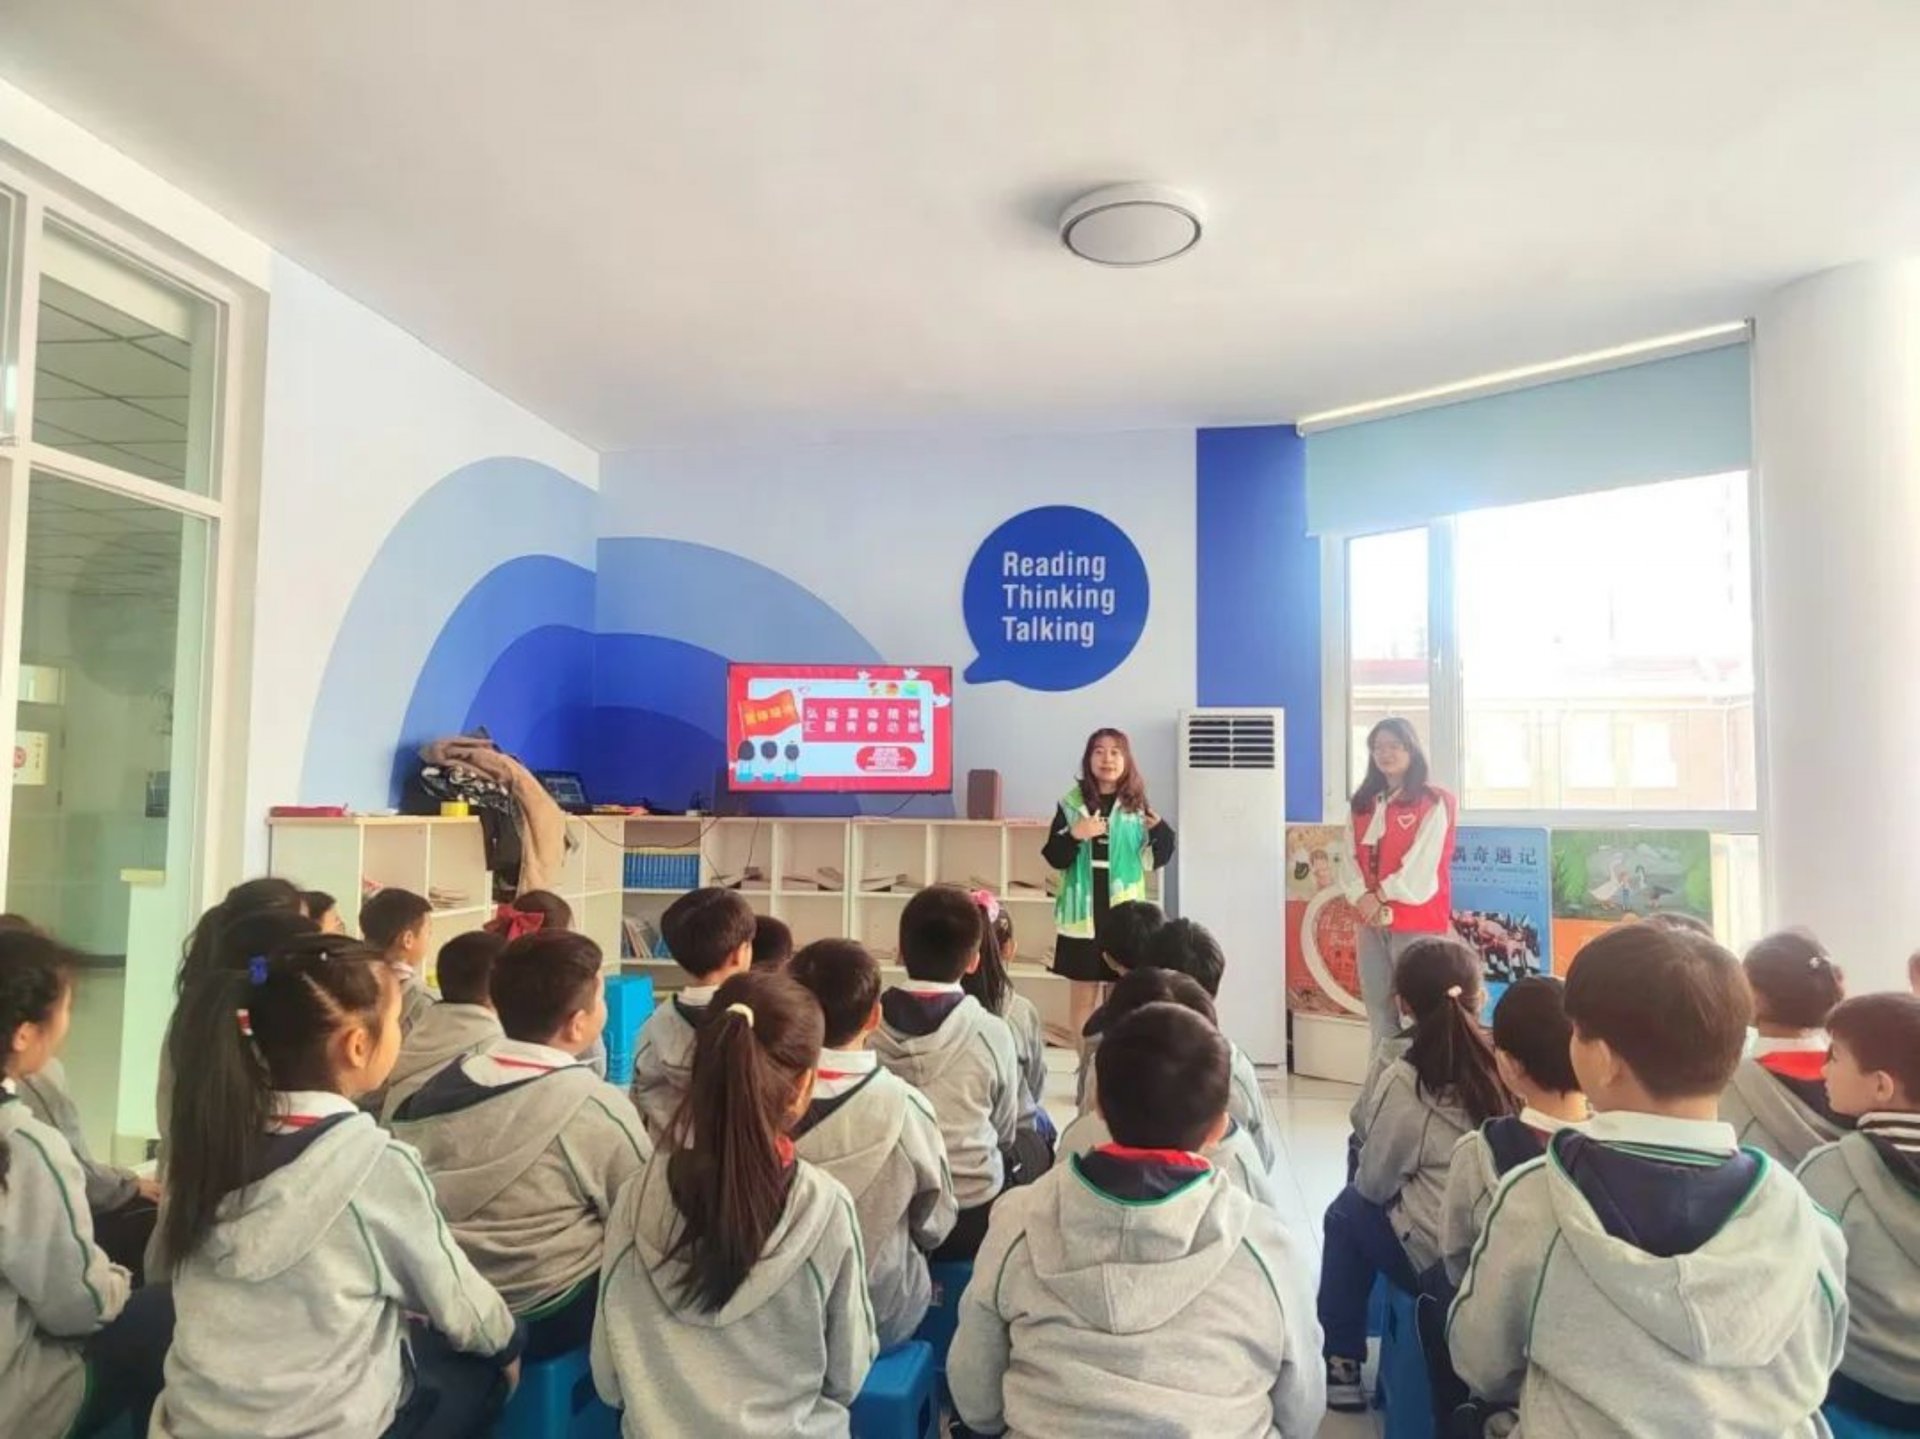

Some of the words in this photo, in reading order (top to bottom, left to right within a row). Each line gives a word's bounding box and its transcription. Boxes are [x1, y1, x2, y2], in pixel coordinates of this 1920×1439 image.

[1003, 550, 1106, 582] Reading
[1002, 583, 1115, 615] Thinking
[1002, 616, 1095, 647] Talking
